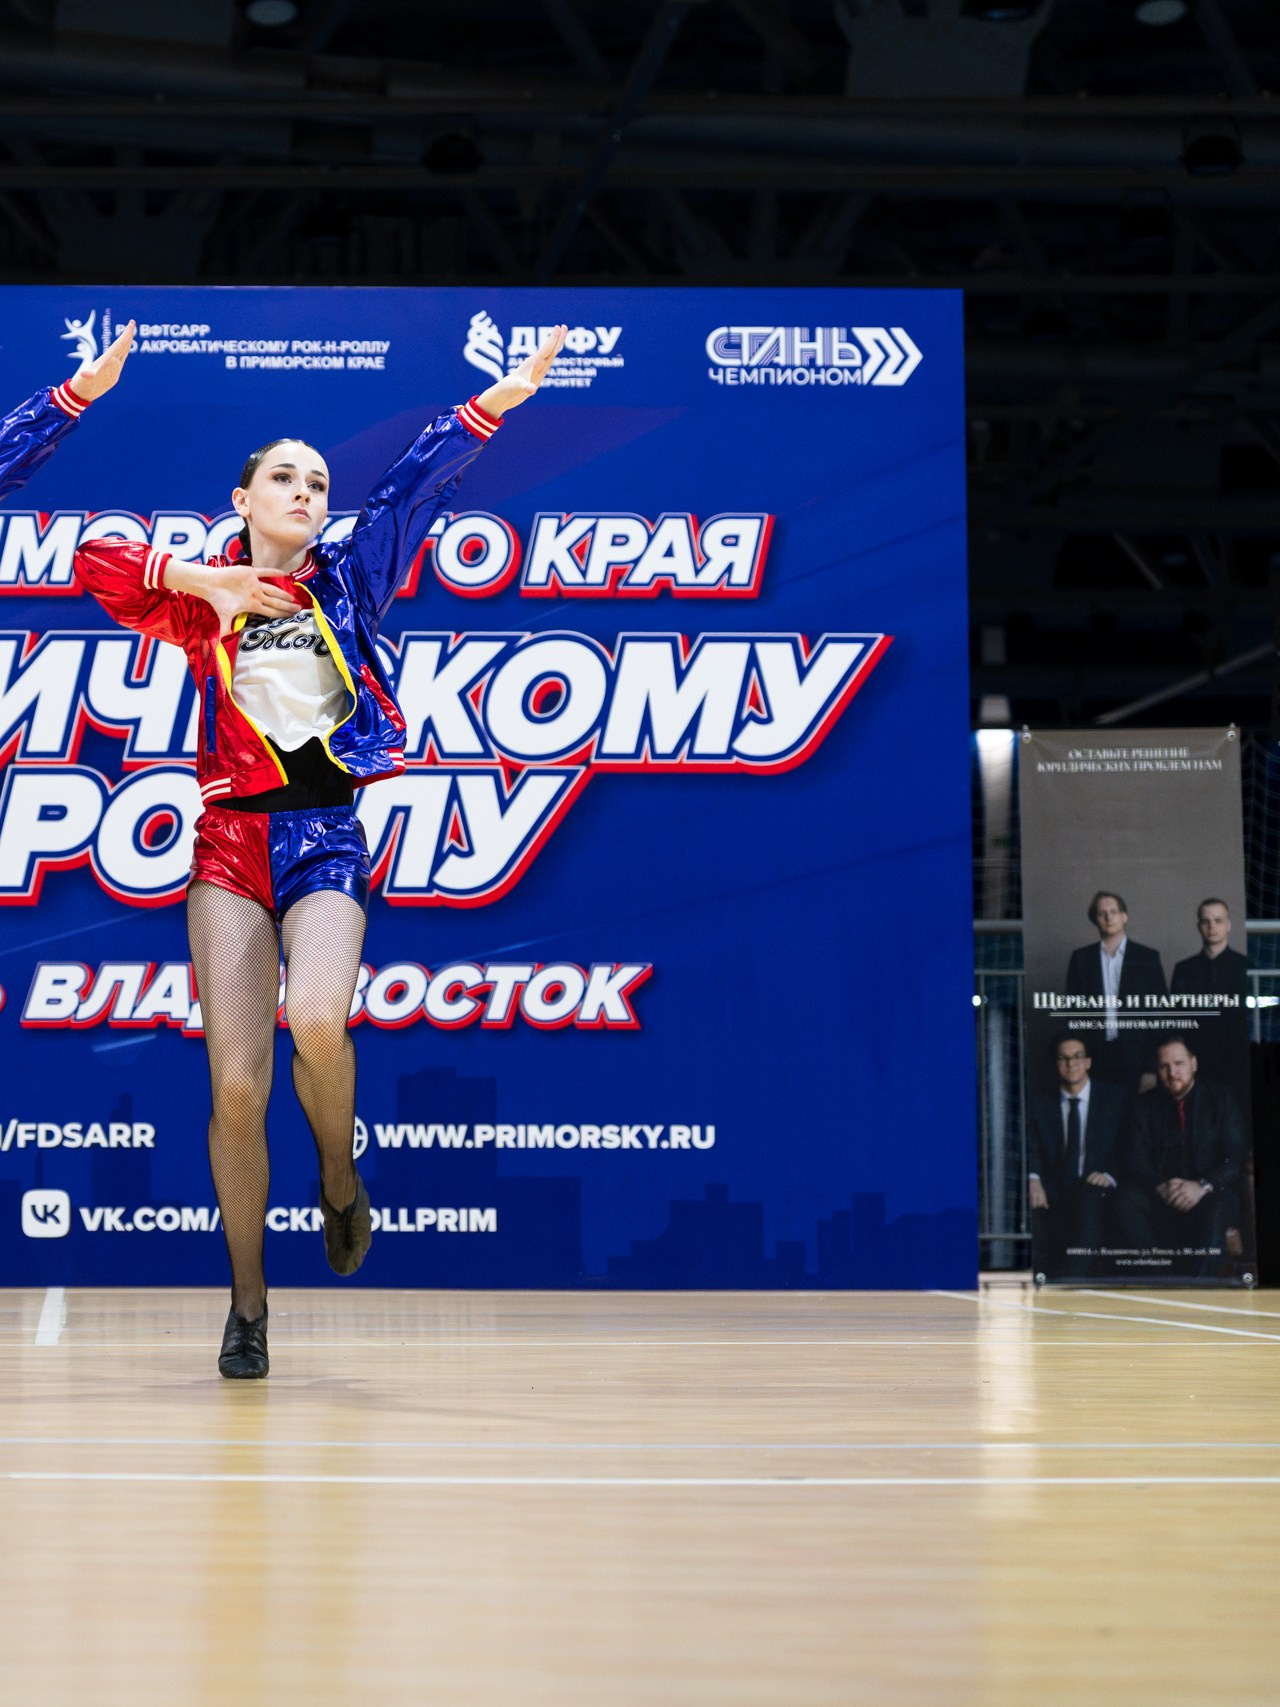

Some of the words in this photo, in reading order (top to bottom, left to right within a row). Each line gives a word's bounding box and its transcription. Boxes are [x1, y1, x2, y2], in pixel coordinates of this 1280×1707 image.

[139, 324, 211, 337] ВФТСАРР
[140, 340, 288, 354] АКРОБАТИЧЕСКОМУ
[291, 340, 390, 354] РОК-Н-РОЛЛУ
[705, 326, 863, 367] СТАНЬ
[225, 356, 237, 368] В
[239, 356, 345, 369] ПРИМОРСКОМ
[347, 356, 385, 369] КРАЕ
[708, 367, 865, 386] ЧЕМПИОНОМ
[522, 511, 774, 594] КРАЯ
[1194, 760, 1222, 771] НАМ
[22, 961, 652, 1035] ВЛАОСТОК
[1126, 994, 1140, 1008] И
[1144, 993, 1240, 1008] ПАРТНЕРЫ
[373, 1122, 717, 1151] WWW.PRIMORSKY.RU
[79, 1206, 498, 1234] VK.COM/CKNLLPRIM
